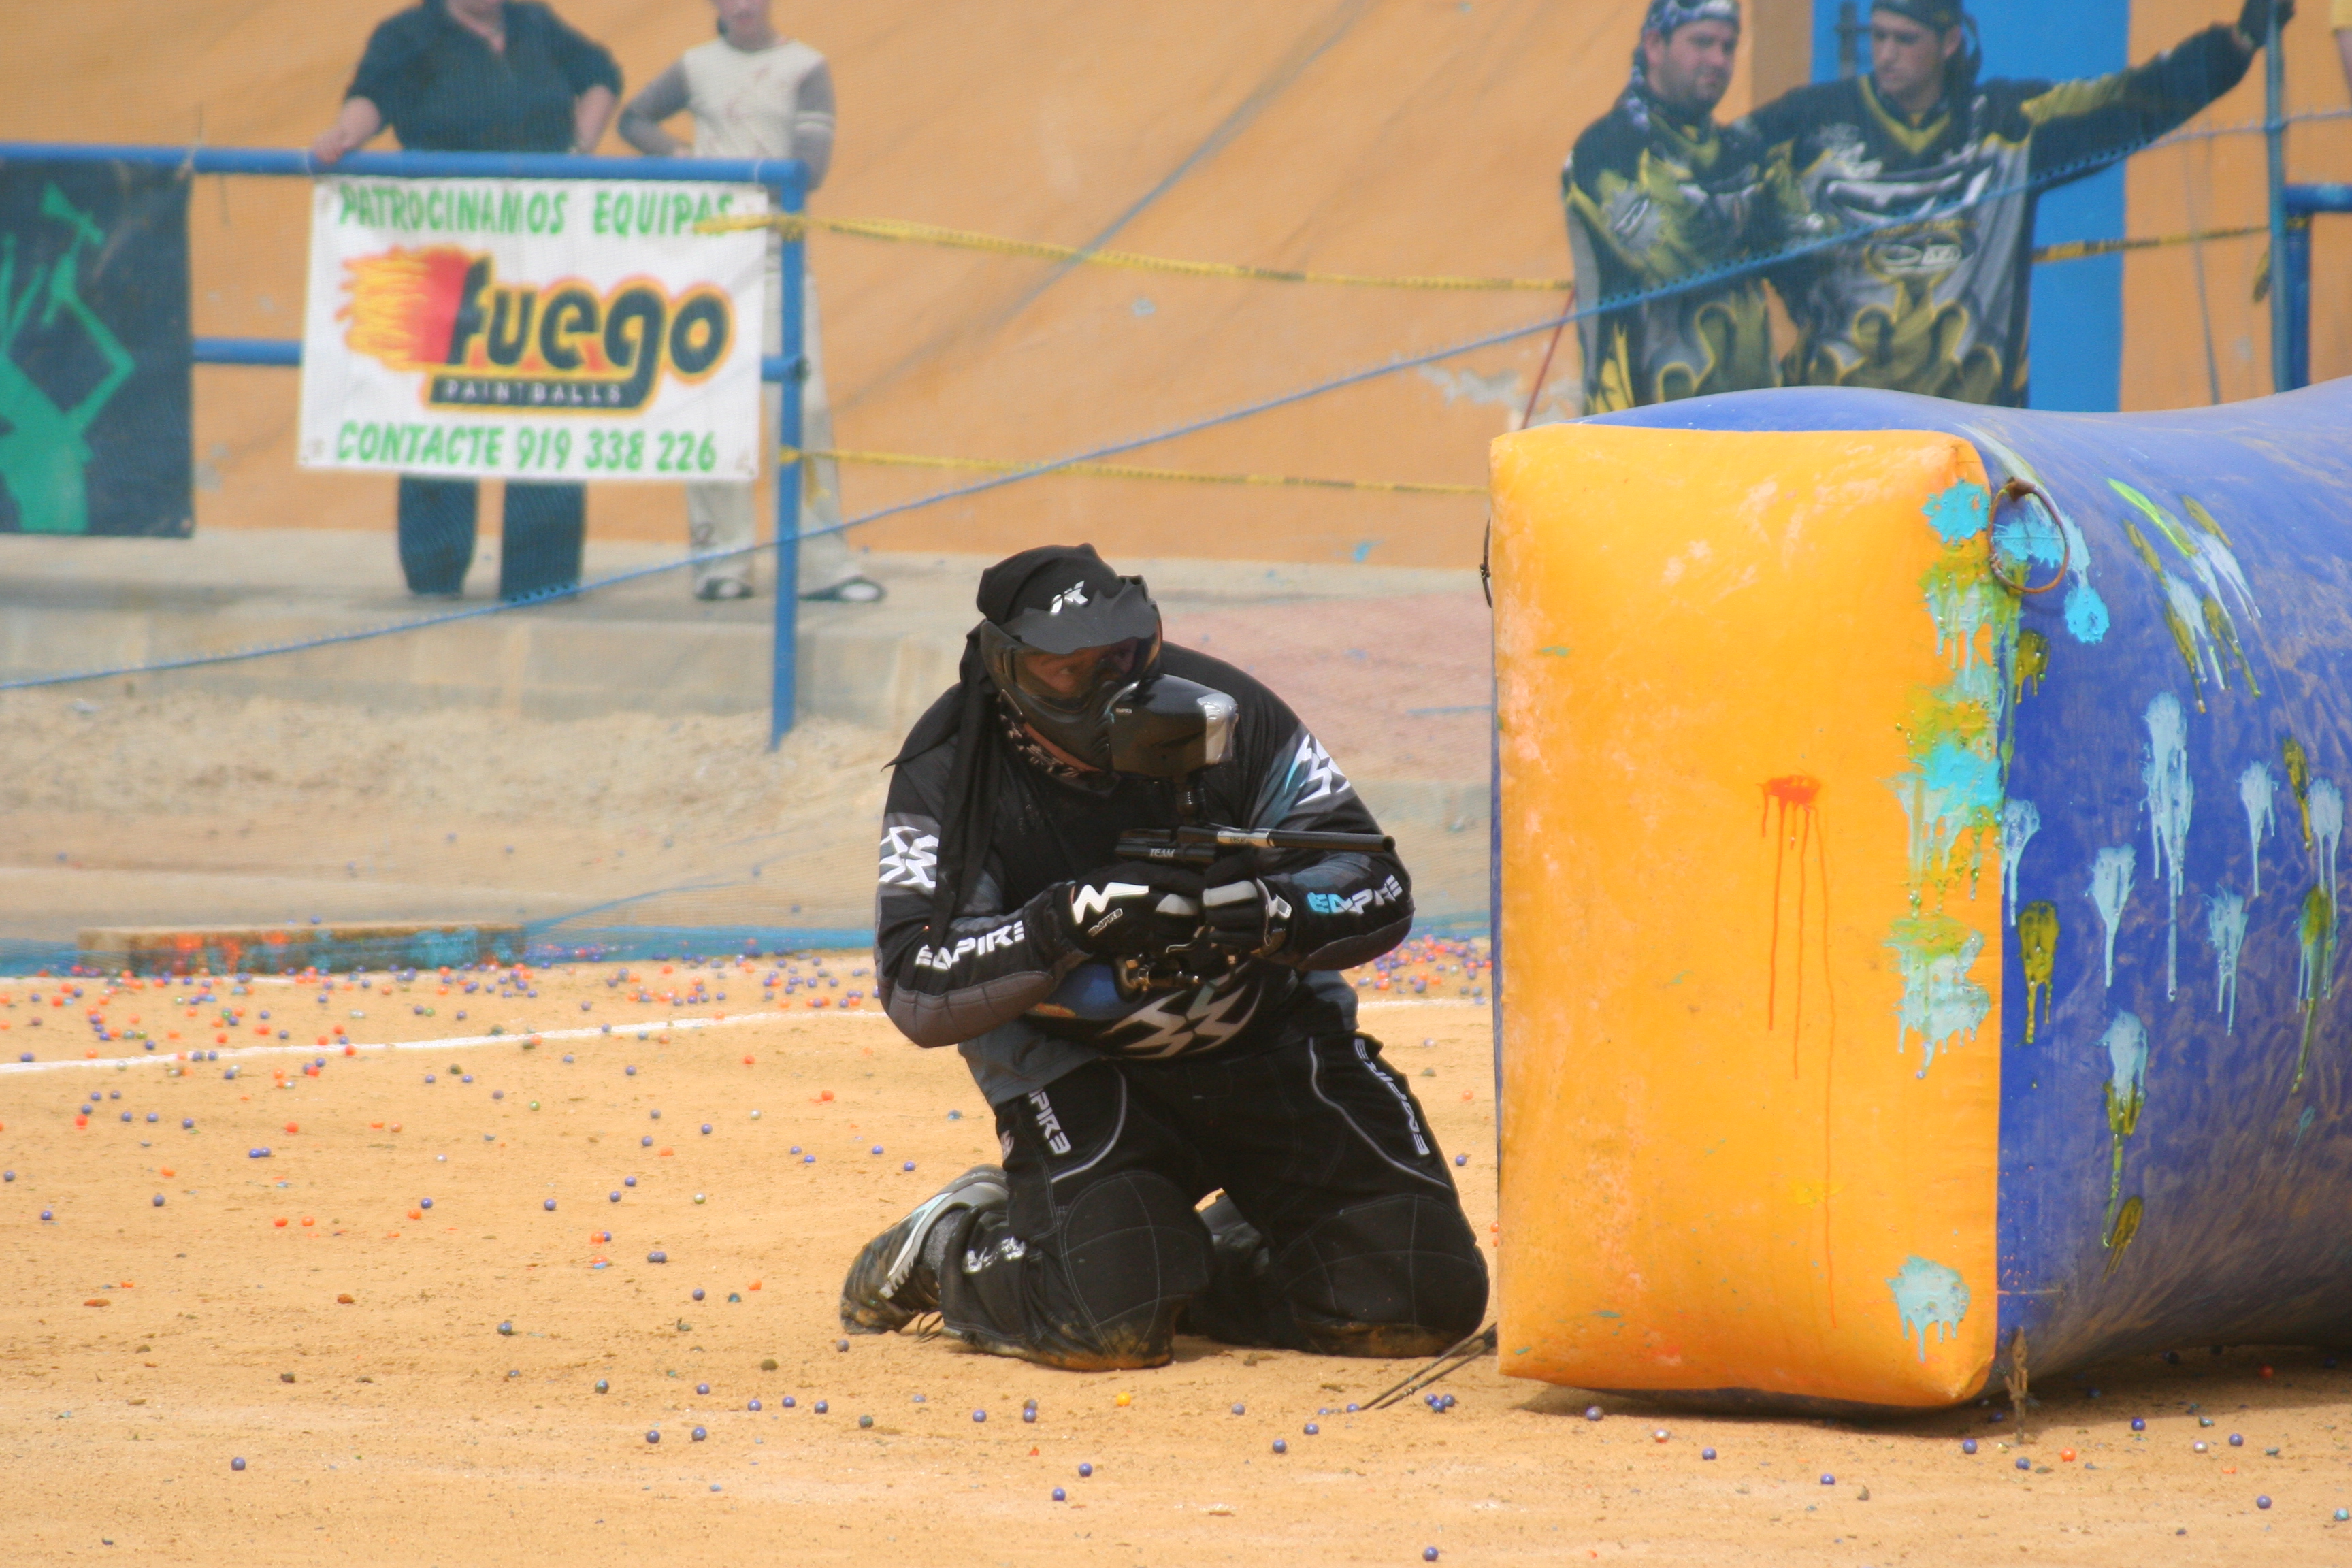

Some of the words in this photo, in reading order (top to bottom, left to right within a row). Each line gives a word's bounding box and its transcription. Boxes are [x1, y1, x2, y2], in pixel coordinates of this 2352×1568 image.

[446, 378, 621, 404] PAINTBALLS
[336, 421, 505, 468] CONTACTE
[515, 425, 572, 470] 919
[584, 429, 645, 472] 338
[655, 430, 717, 472] 226
[1149, 848, 1176, 858] TEAM
[1088, 907, 1124, 936] EMPIRE
[1028, 1090, 1071, 1155] PIRE
